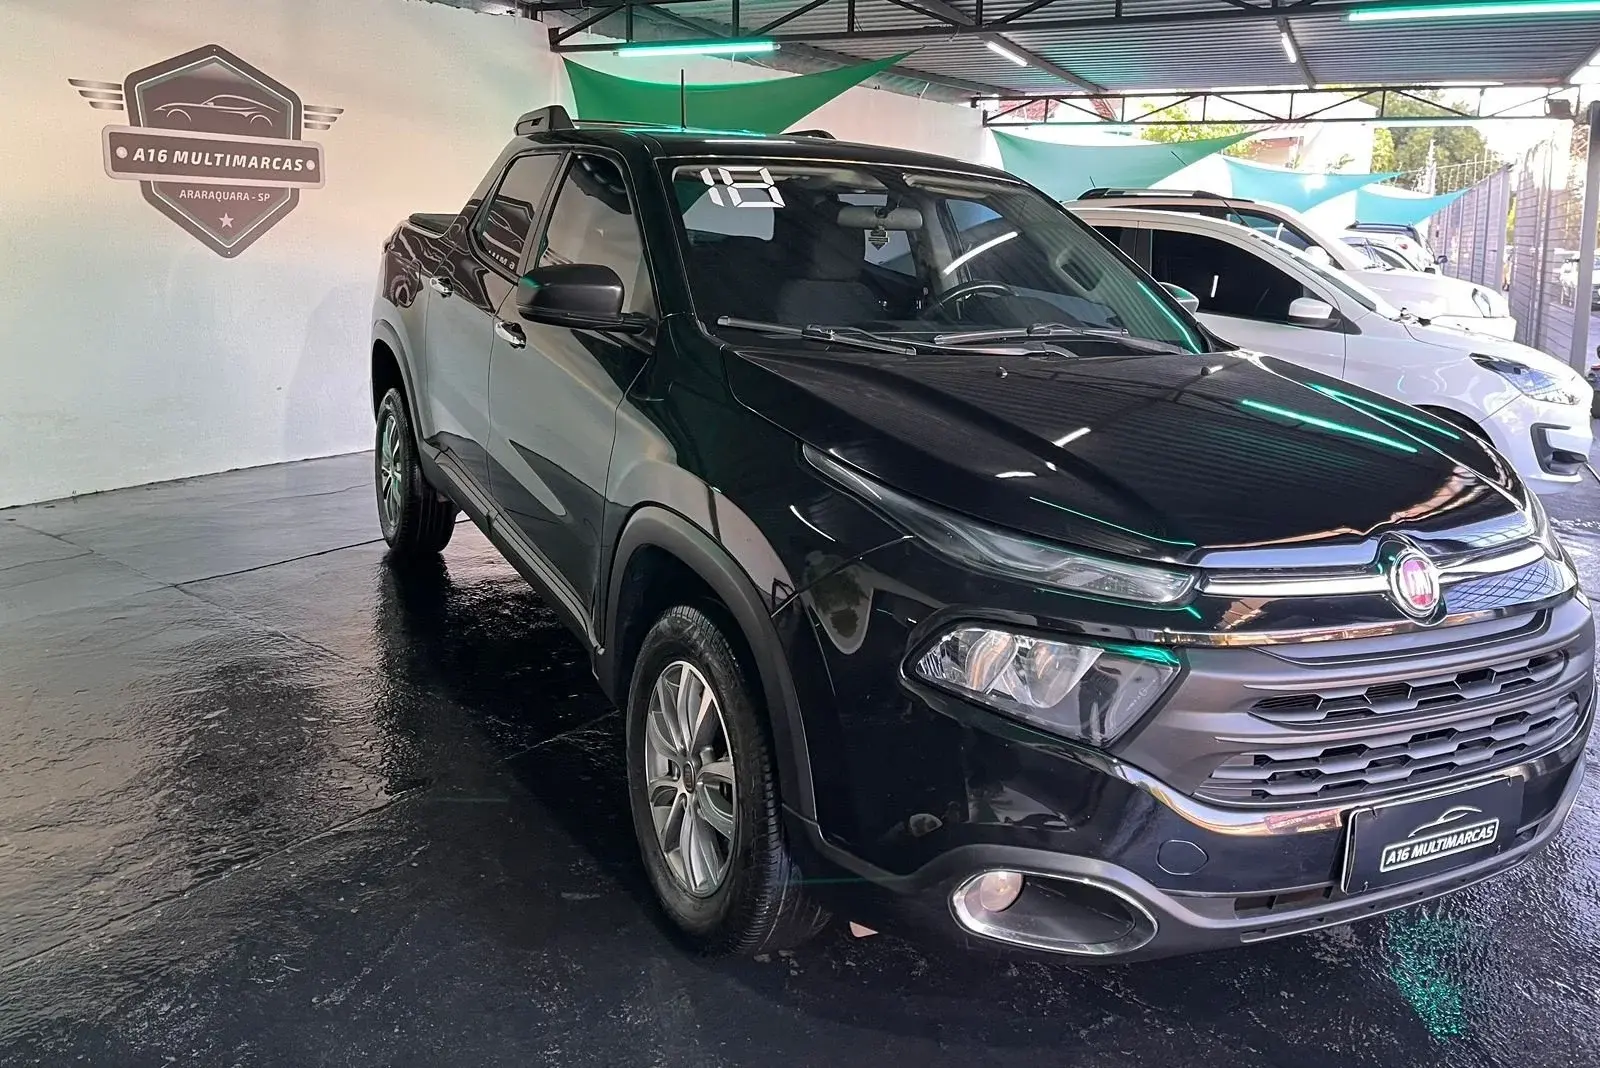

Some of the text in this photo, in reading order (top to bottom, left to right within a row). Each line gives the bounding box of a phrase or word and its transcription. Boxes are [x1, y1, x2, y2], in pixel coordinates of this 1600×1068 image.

[133, 147, 304, 171] A16 MULTIMARCAS
[179, 189, 250, 202] ARARAQUARA
[257, 192, 271, 202] SP
[700, 166, 786, 208] 18
[1386, 825, 1495, 865] A16 MULTIMARCAS
